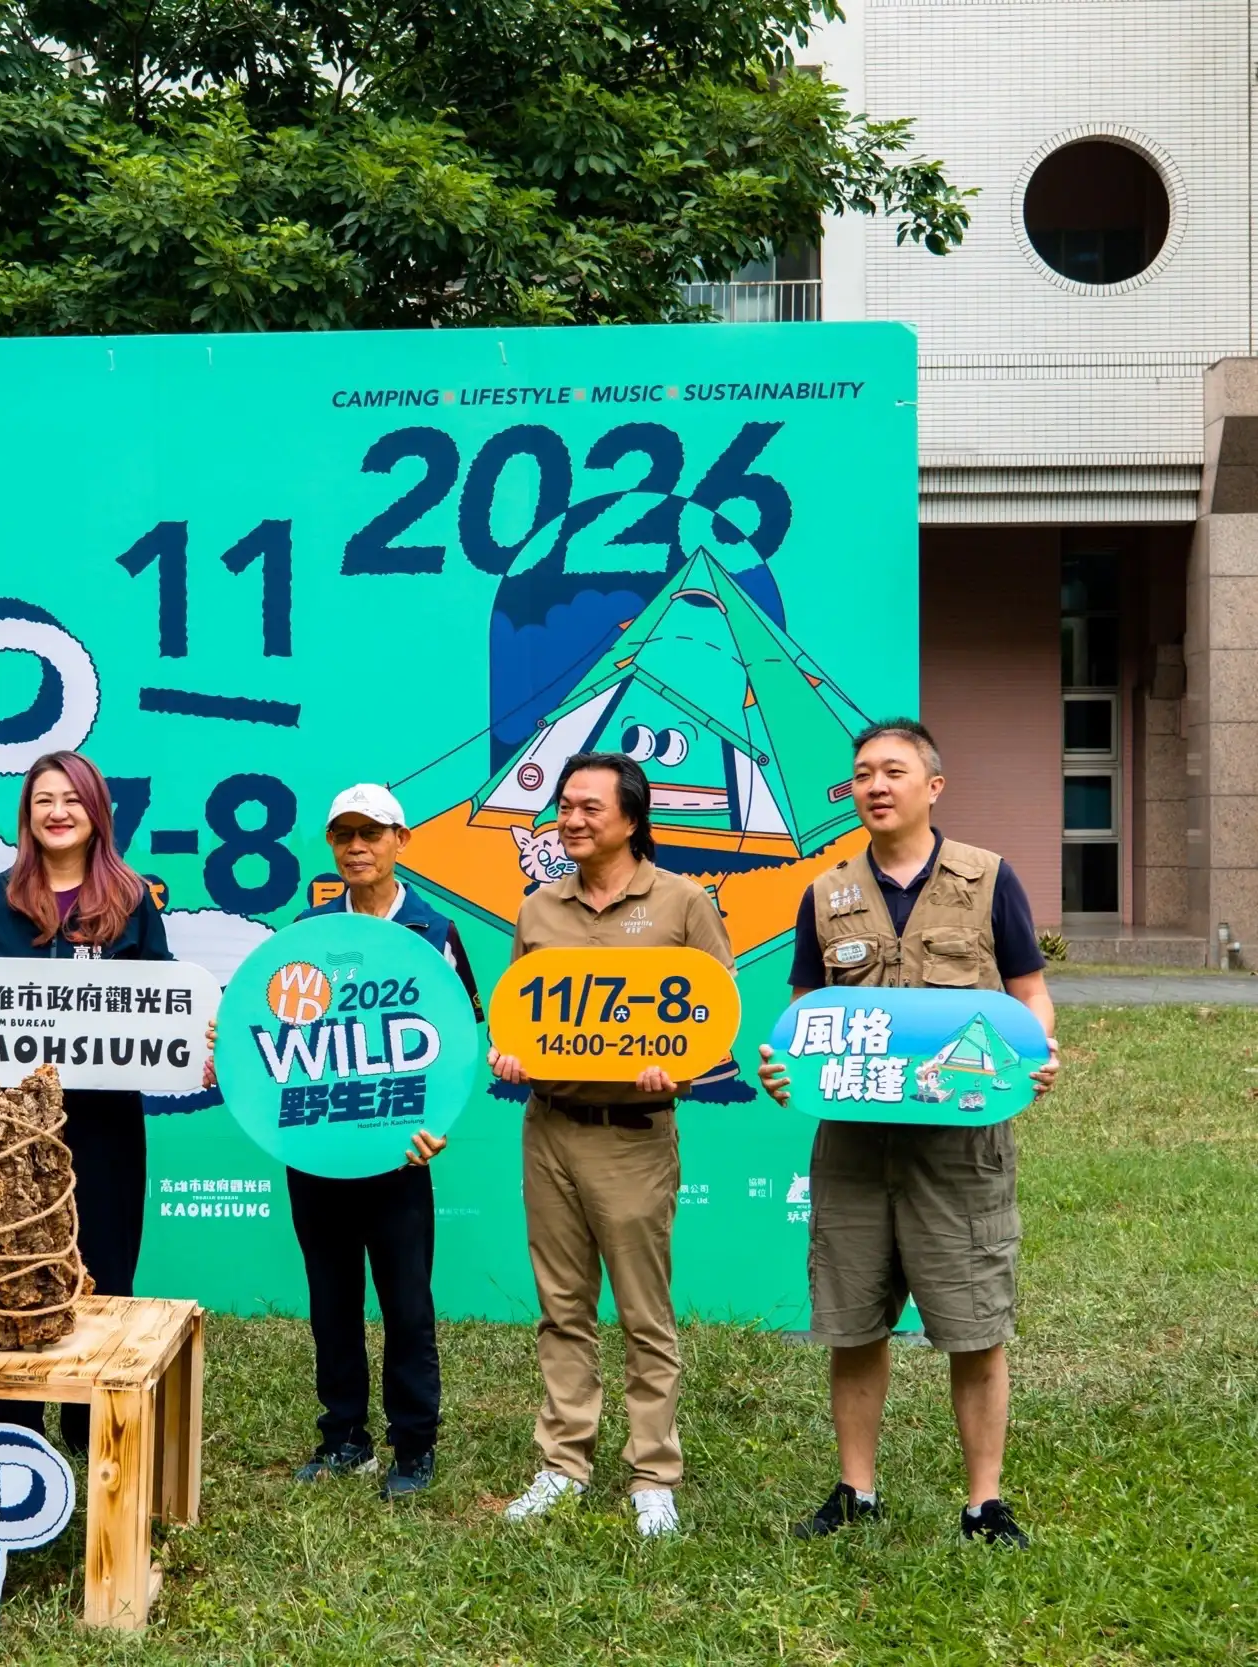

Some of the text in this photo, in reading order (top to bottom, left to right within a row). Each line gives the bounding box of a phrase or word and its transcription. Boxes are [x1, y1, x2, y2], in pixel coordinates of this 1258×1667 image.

[333, 382, 865, 407] CAMPING LIFESTYLE MUSIC SUSTAINABILITY
[339, 421, 793, 577] 2026
[116, 519, 293, 658] 11
[338, 977, 420, 1012] 2026
[10, 1018, 56, 1027] BUREAU
[788, 1006, 893, 1058] 風格
[251, 1013, 441, 1084] WILD
[536, 1034, 687, 1057] 14:00-21:00
[819, 1056, 908, 1103] 帳篷
[278, 1075, 427, 1128] 野生活
[357, 1121, 382, 1129] Hosted
[390, 1118, 425, 1127] Kaohsiung
[160, 1178, 272, 1193] 高雄市政府觀光局
[679, 1184, 709, 1194] 限公司
[160, 1202, 271, 1218] KAOHSIUNG
